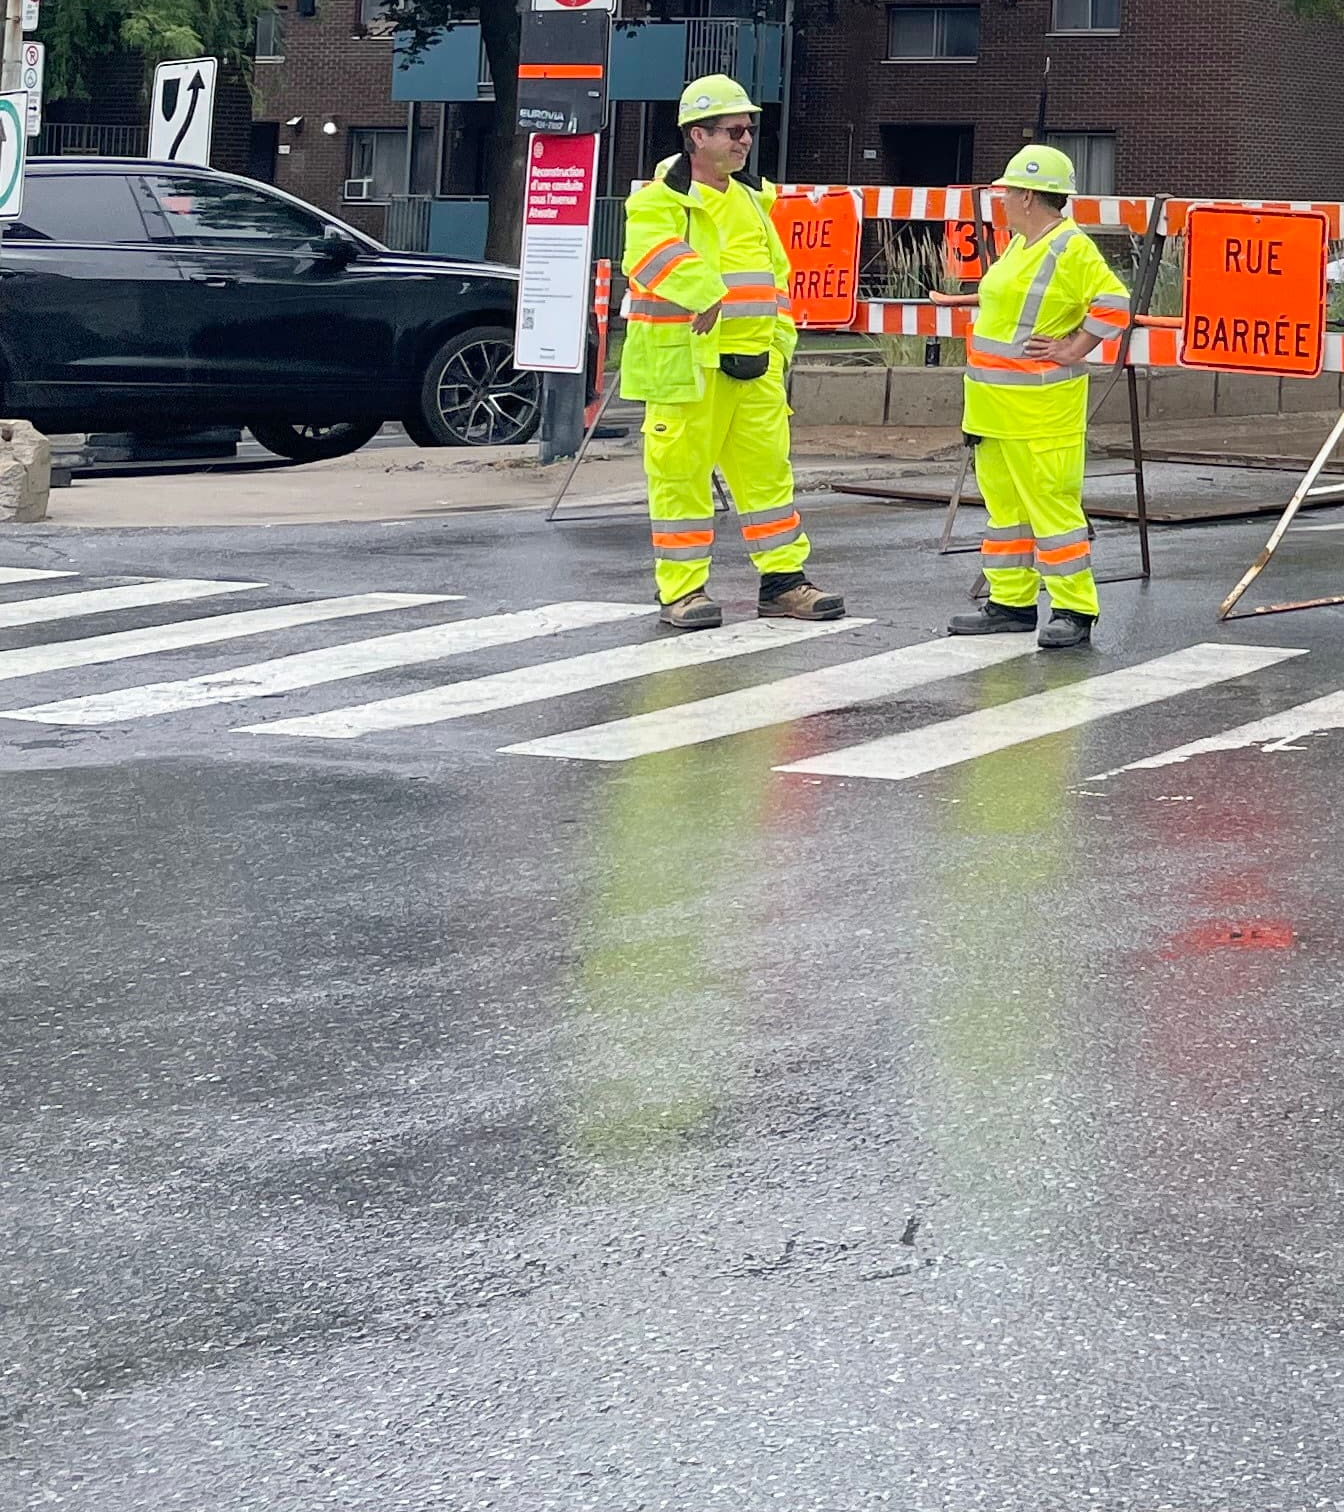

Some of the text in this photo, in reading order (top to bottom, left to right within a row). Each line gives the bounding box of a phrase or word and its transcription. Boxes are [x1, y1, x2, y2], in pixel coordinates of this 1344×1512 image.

[520, 109, 564, 120] EUROVIA
[791, 220, 833, 249] RUE
[1225, 238, 1283, 276] RUE
[789, 264, 849, 300] RRÉE
[1193, 314, 1312, 358] BARRÉE
